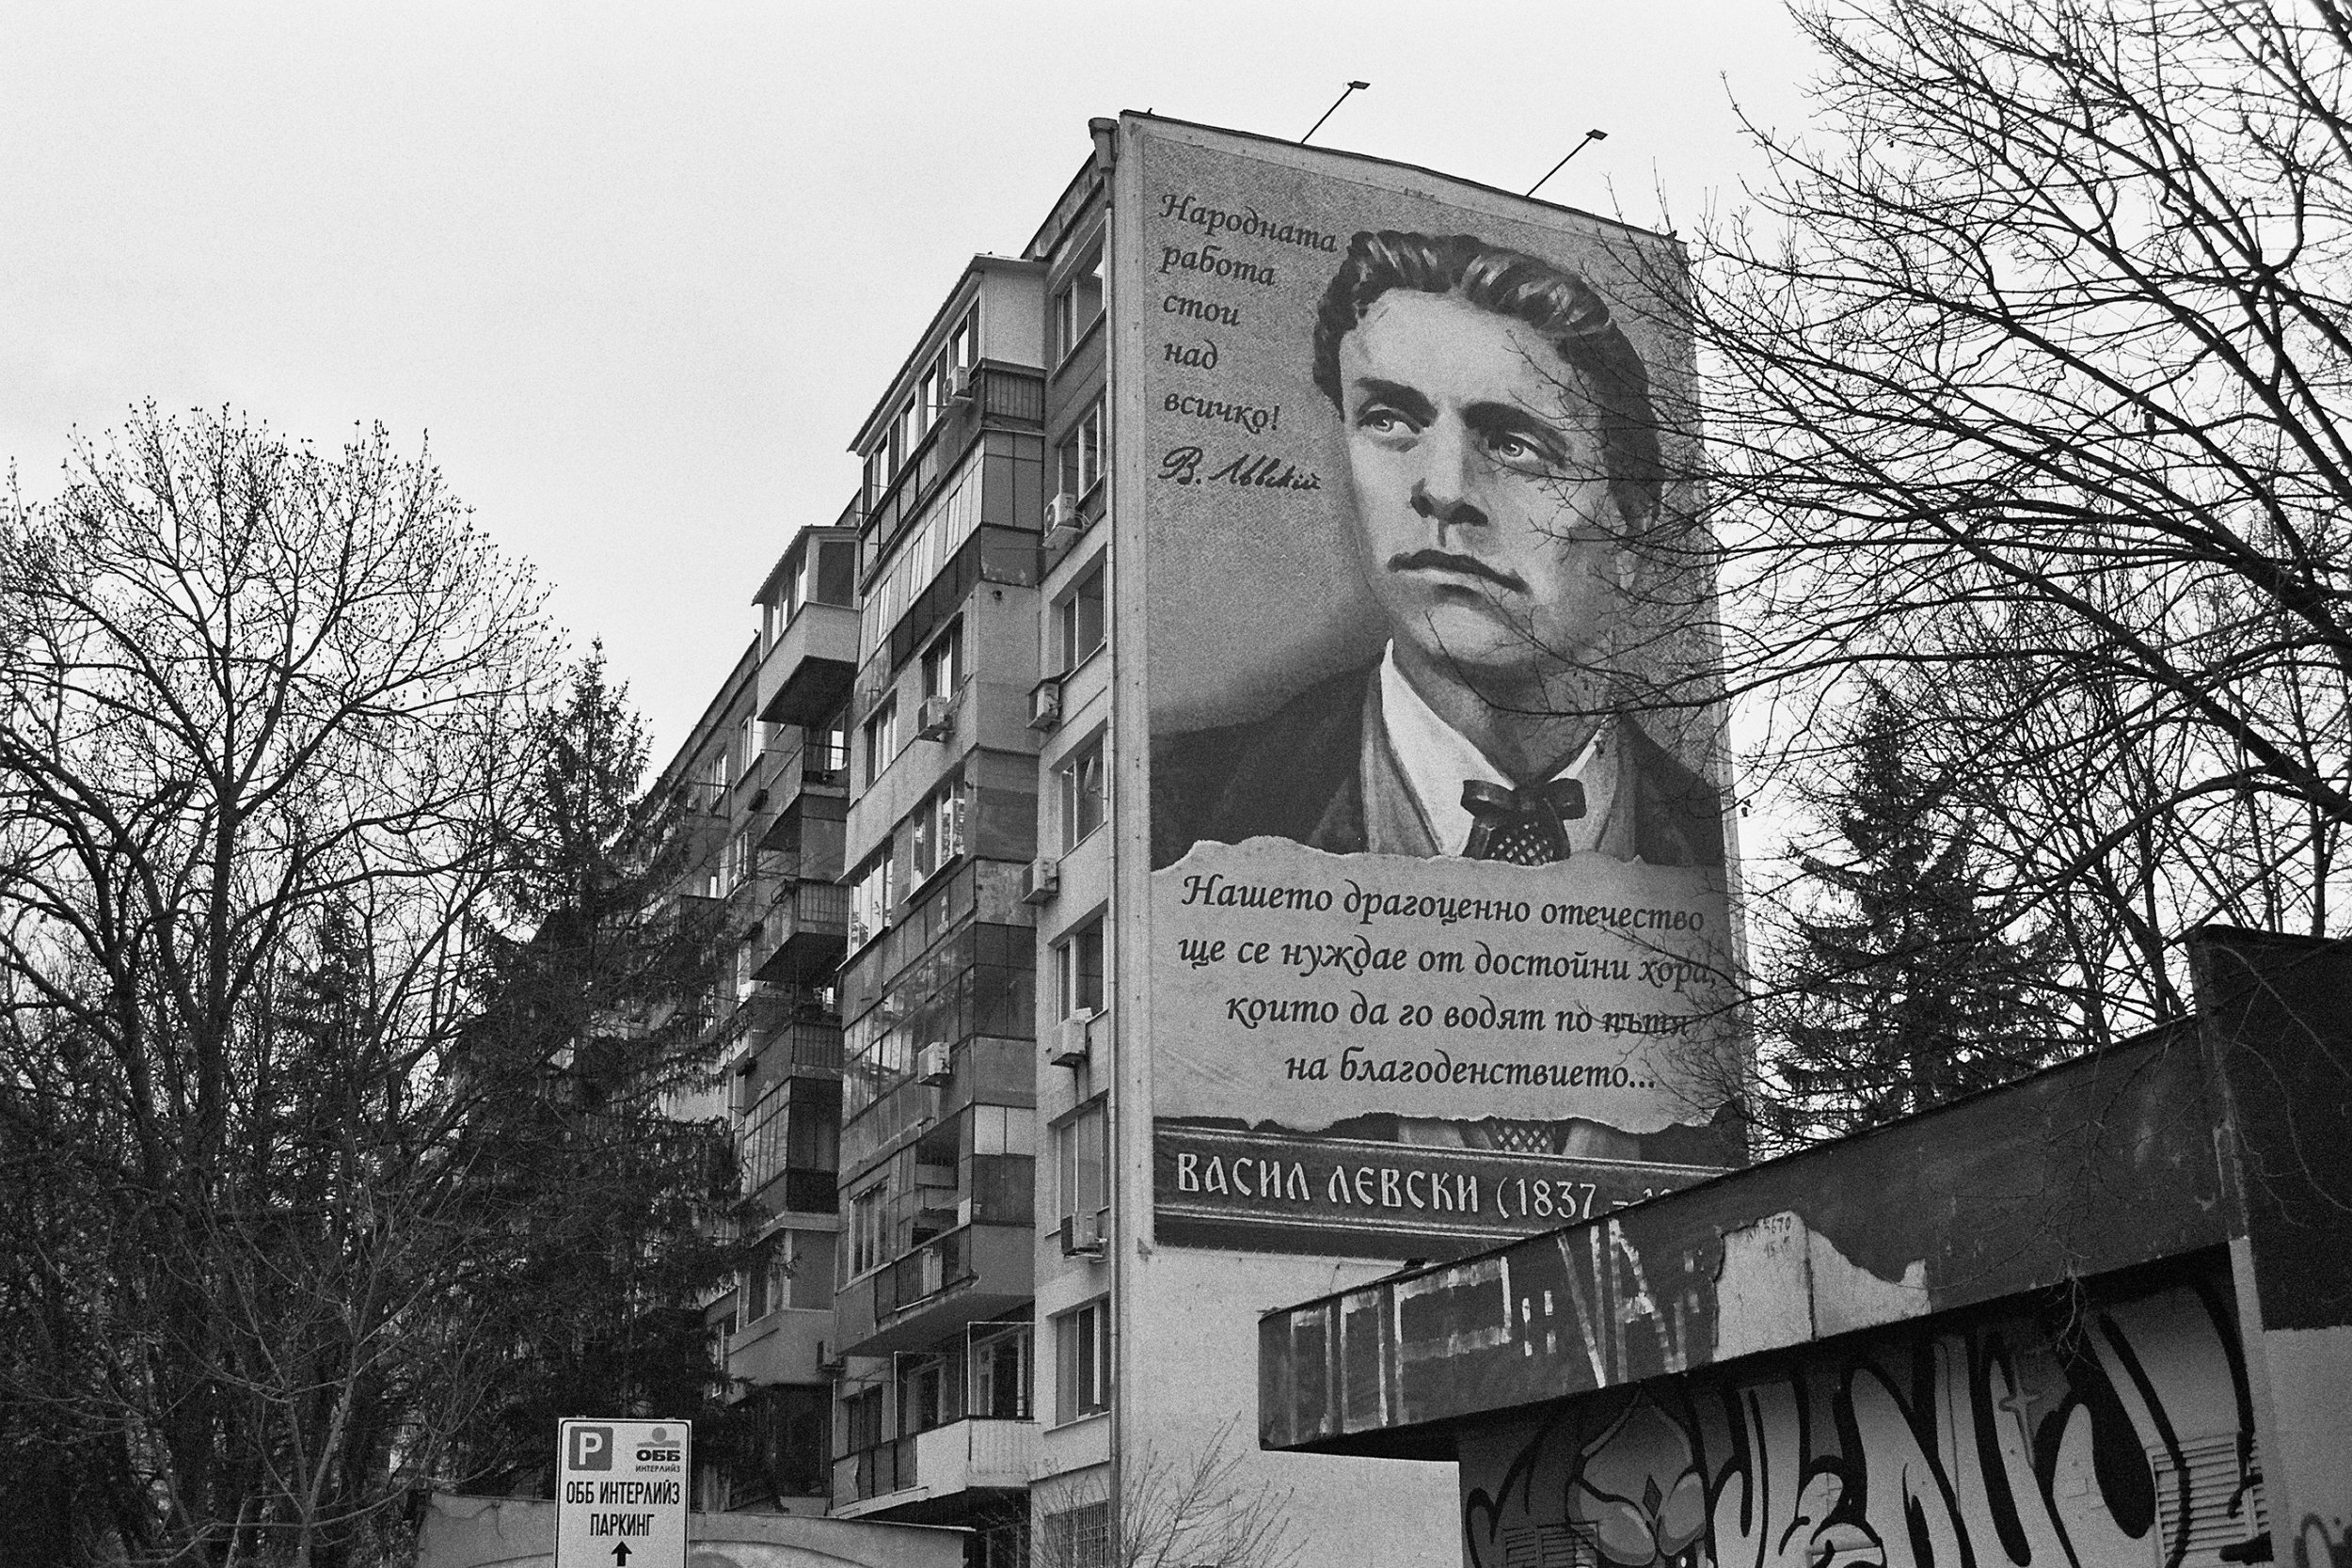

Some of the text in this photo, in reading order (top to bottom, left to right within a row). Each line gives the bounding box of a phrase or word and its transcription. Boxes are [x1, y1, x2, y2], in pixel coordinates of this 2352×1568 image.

[1159, 194, 1337, 252] Народната
[1158, 245, 1275, 286] работа
[1163, 294, 1240, 326] стои
[1163, 338, 1218, 371] над
[1164, 392, 1280, 435] всичко!
[1158, 447, 1201, 484] В.
[1182, 874, 1704, 931] Нашето драгоценно отечество
[1178, 933, 1717, 993] ще се нуждае от достойни хора,
[1225, 995, 1340, 1030] които
[1349, 989, 1389, 1026] да
[1398, 1003, 1433, 1028] го
[1443, 993, 1545, 1032] водят
[1555, 1010, 1593, 1034] по
[1284, 1047, 1656, 1088] на благоденствието...
[1178, 1153, 1310, 1200] ВАСИЛ
[1327, 1165, 1478, 1212] ЛЕВСКИ
[1497, 1177, 1597, 1219] (1837
[580, 1432, 603, 1465] P
[636, 1449, 681, 1462] ОББ
[635, 1465, 680, 1473] ИНТЕРЛИЙЗ
[566, 1480, 680, 1505] ОББ ИНТЕРЛИЙЗ
[590, 1513, 655, 1536] ПАРКИНГ
